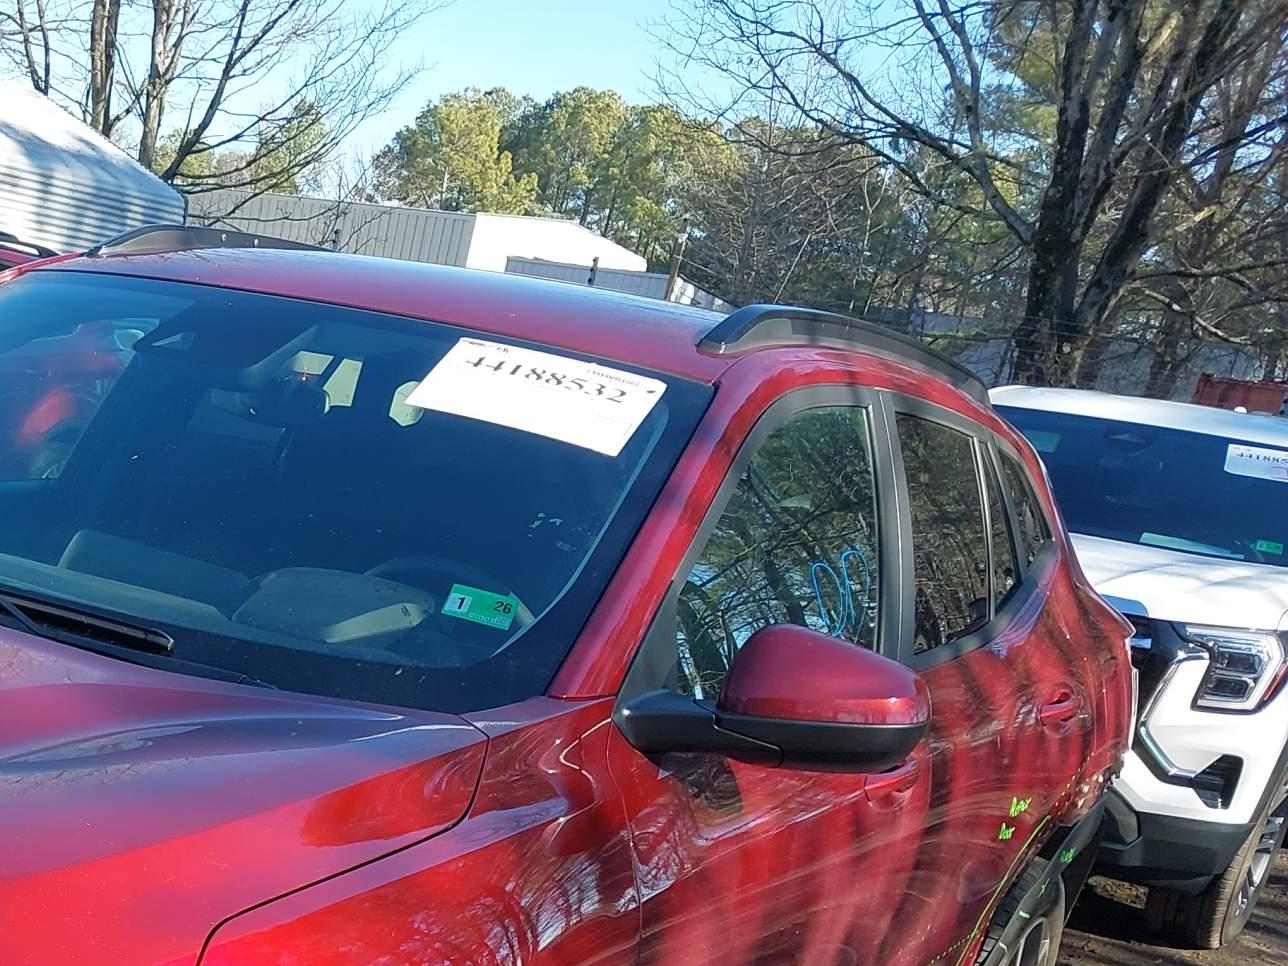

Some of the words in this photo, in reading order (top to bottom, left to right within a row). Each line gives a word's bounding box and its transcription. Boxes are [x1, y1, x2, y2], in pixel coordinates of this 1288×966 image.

[465, 355, 627, 404] 44188532
[456, 596, 467, 610] 1
[494, 600, 513, 614] 26
